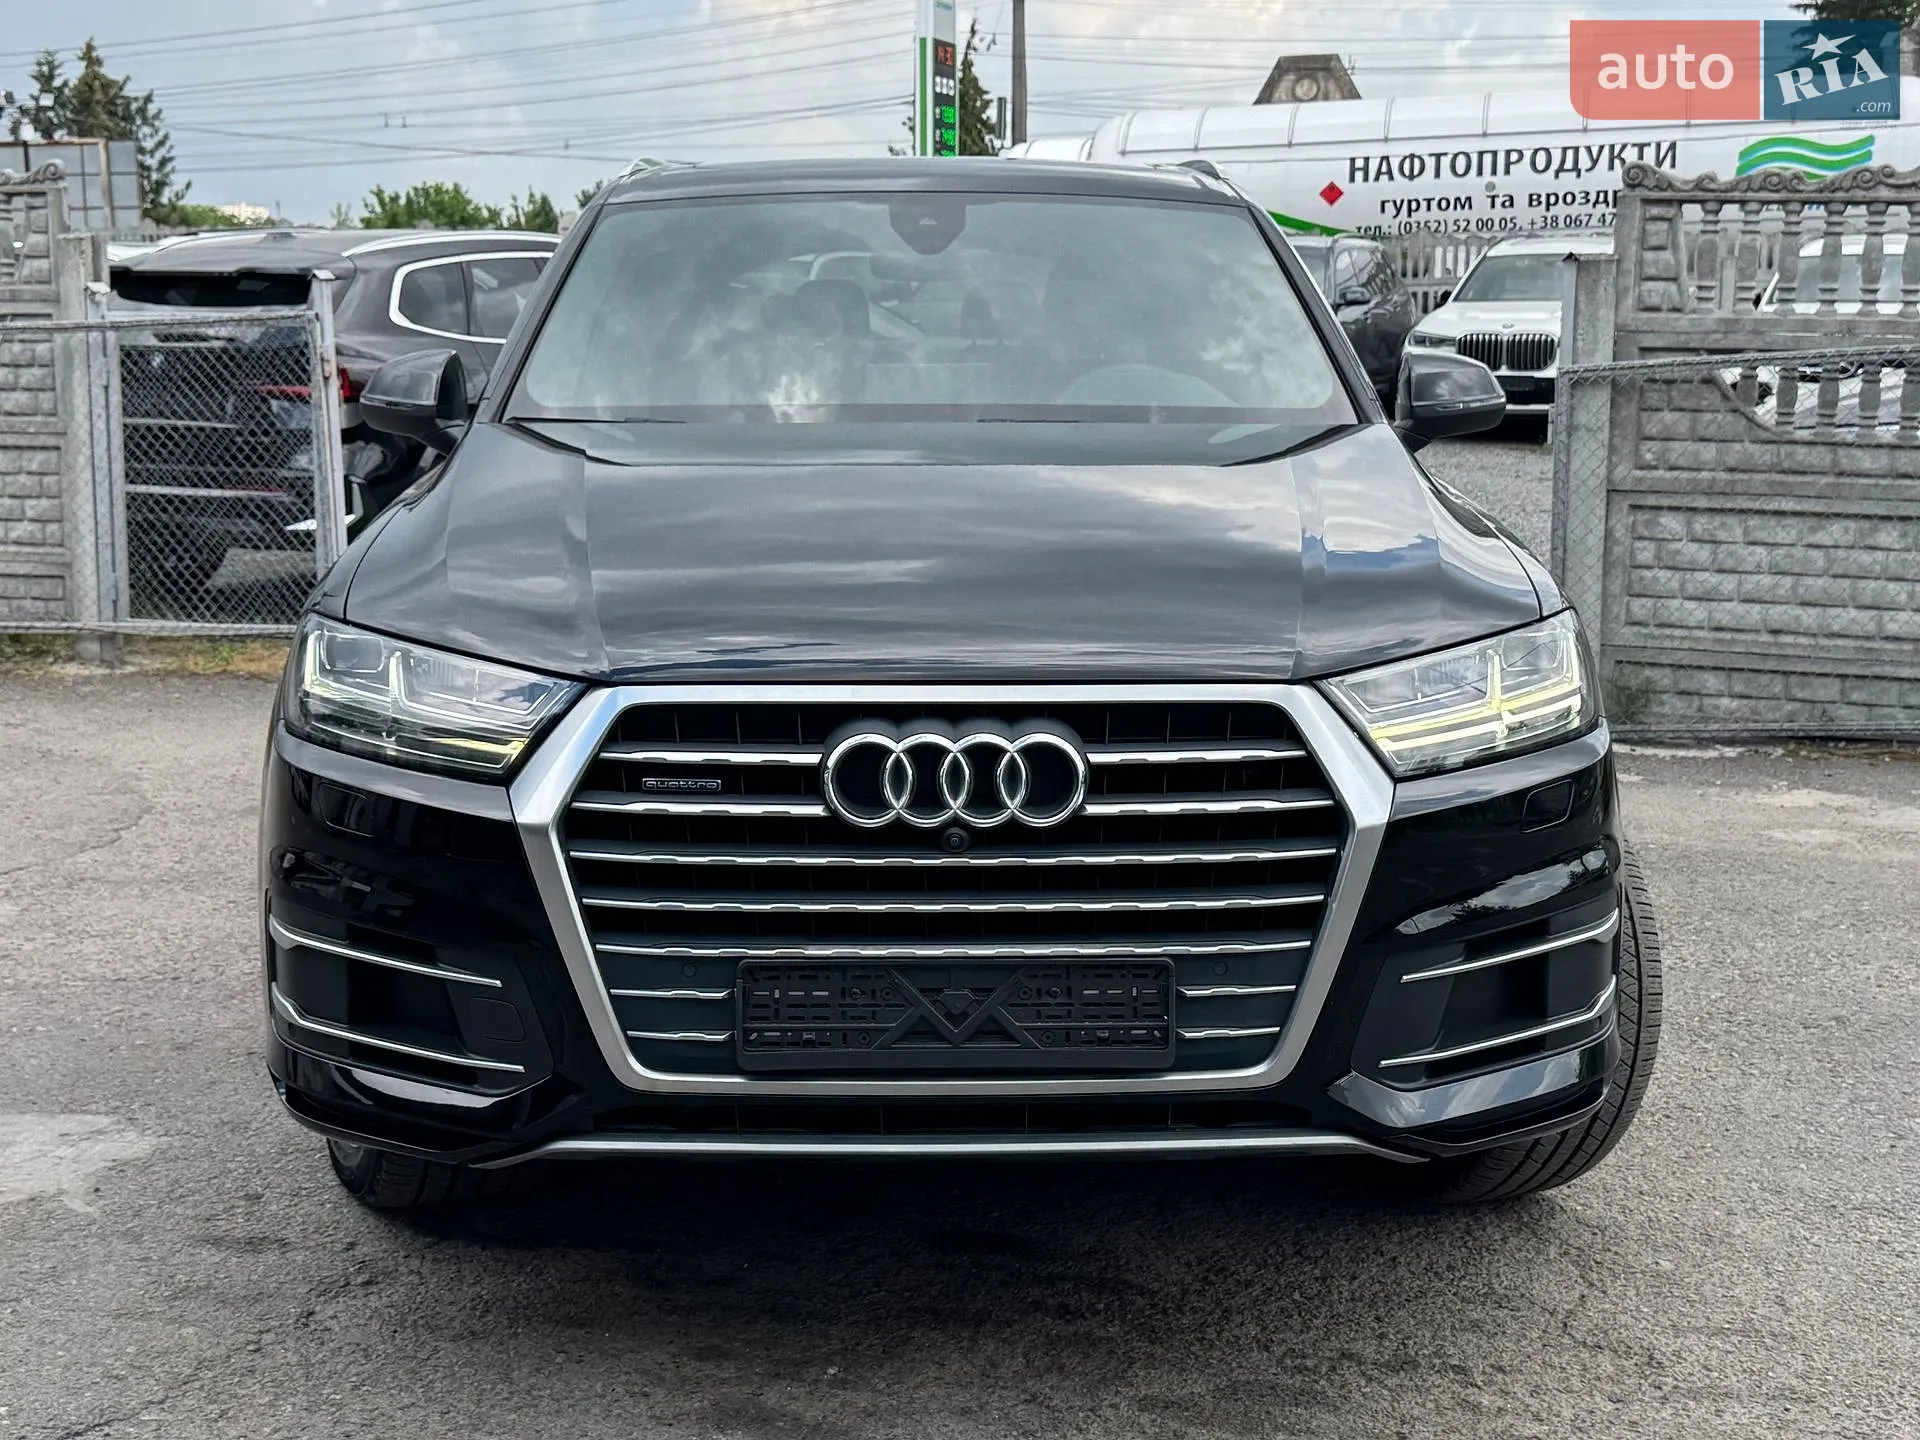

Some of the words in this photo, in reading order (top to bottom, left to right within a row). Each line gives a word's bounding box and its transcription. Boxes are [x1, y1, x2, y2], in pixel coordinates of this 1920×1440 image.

[1348, 141, 1677, 184] НАФТОПРОДУКТИ
[1380, 195, 1473, 219] гуртом
[1486, 193, 1515, 210] та
[1452, 218, 1470, 233] 52
[1475, 217, 1494, 232] 00
[1527, 214, 1559, 230] +38
[1564, 213, 1592, 228] 067
[645, 780, 718, 790] quattro
